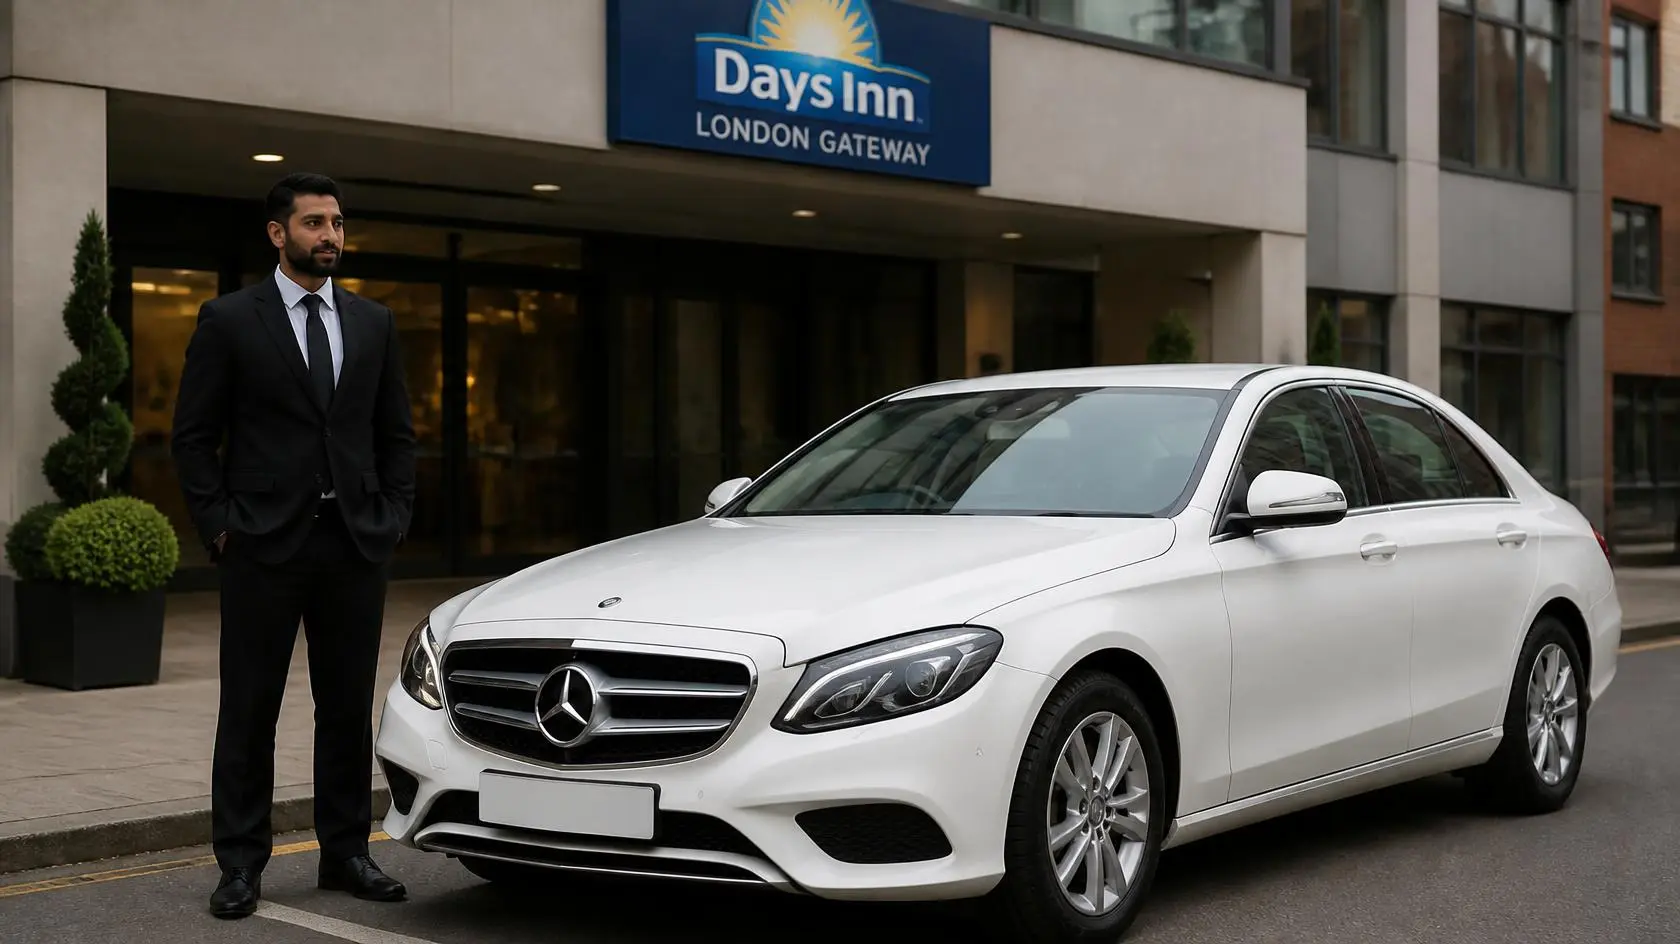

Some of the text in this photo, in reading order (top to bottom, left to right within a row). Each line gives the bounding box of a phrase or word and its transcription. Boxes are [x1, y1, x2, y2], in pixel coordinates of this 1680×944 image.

[715, 48, 914, 122] Days Inn
[696, 112, 931, 166] LONDON GATEWAY
